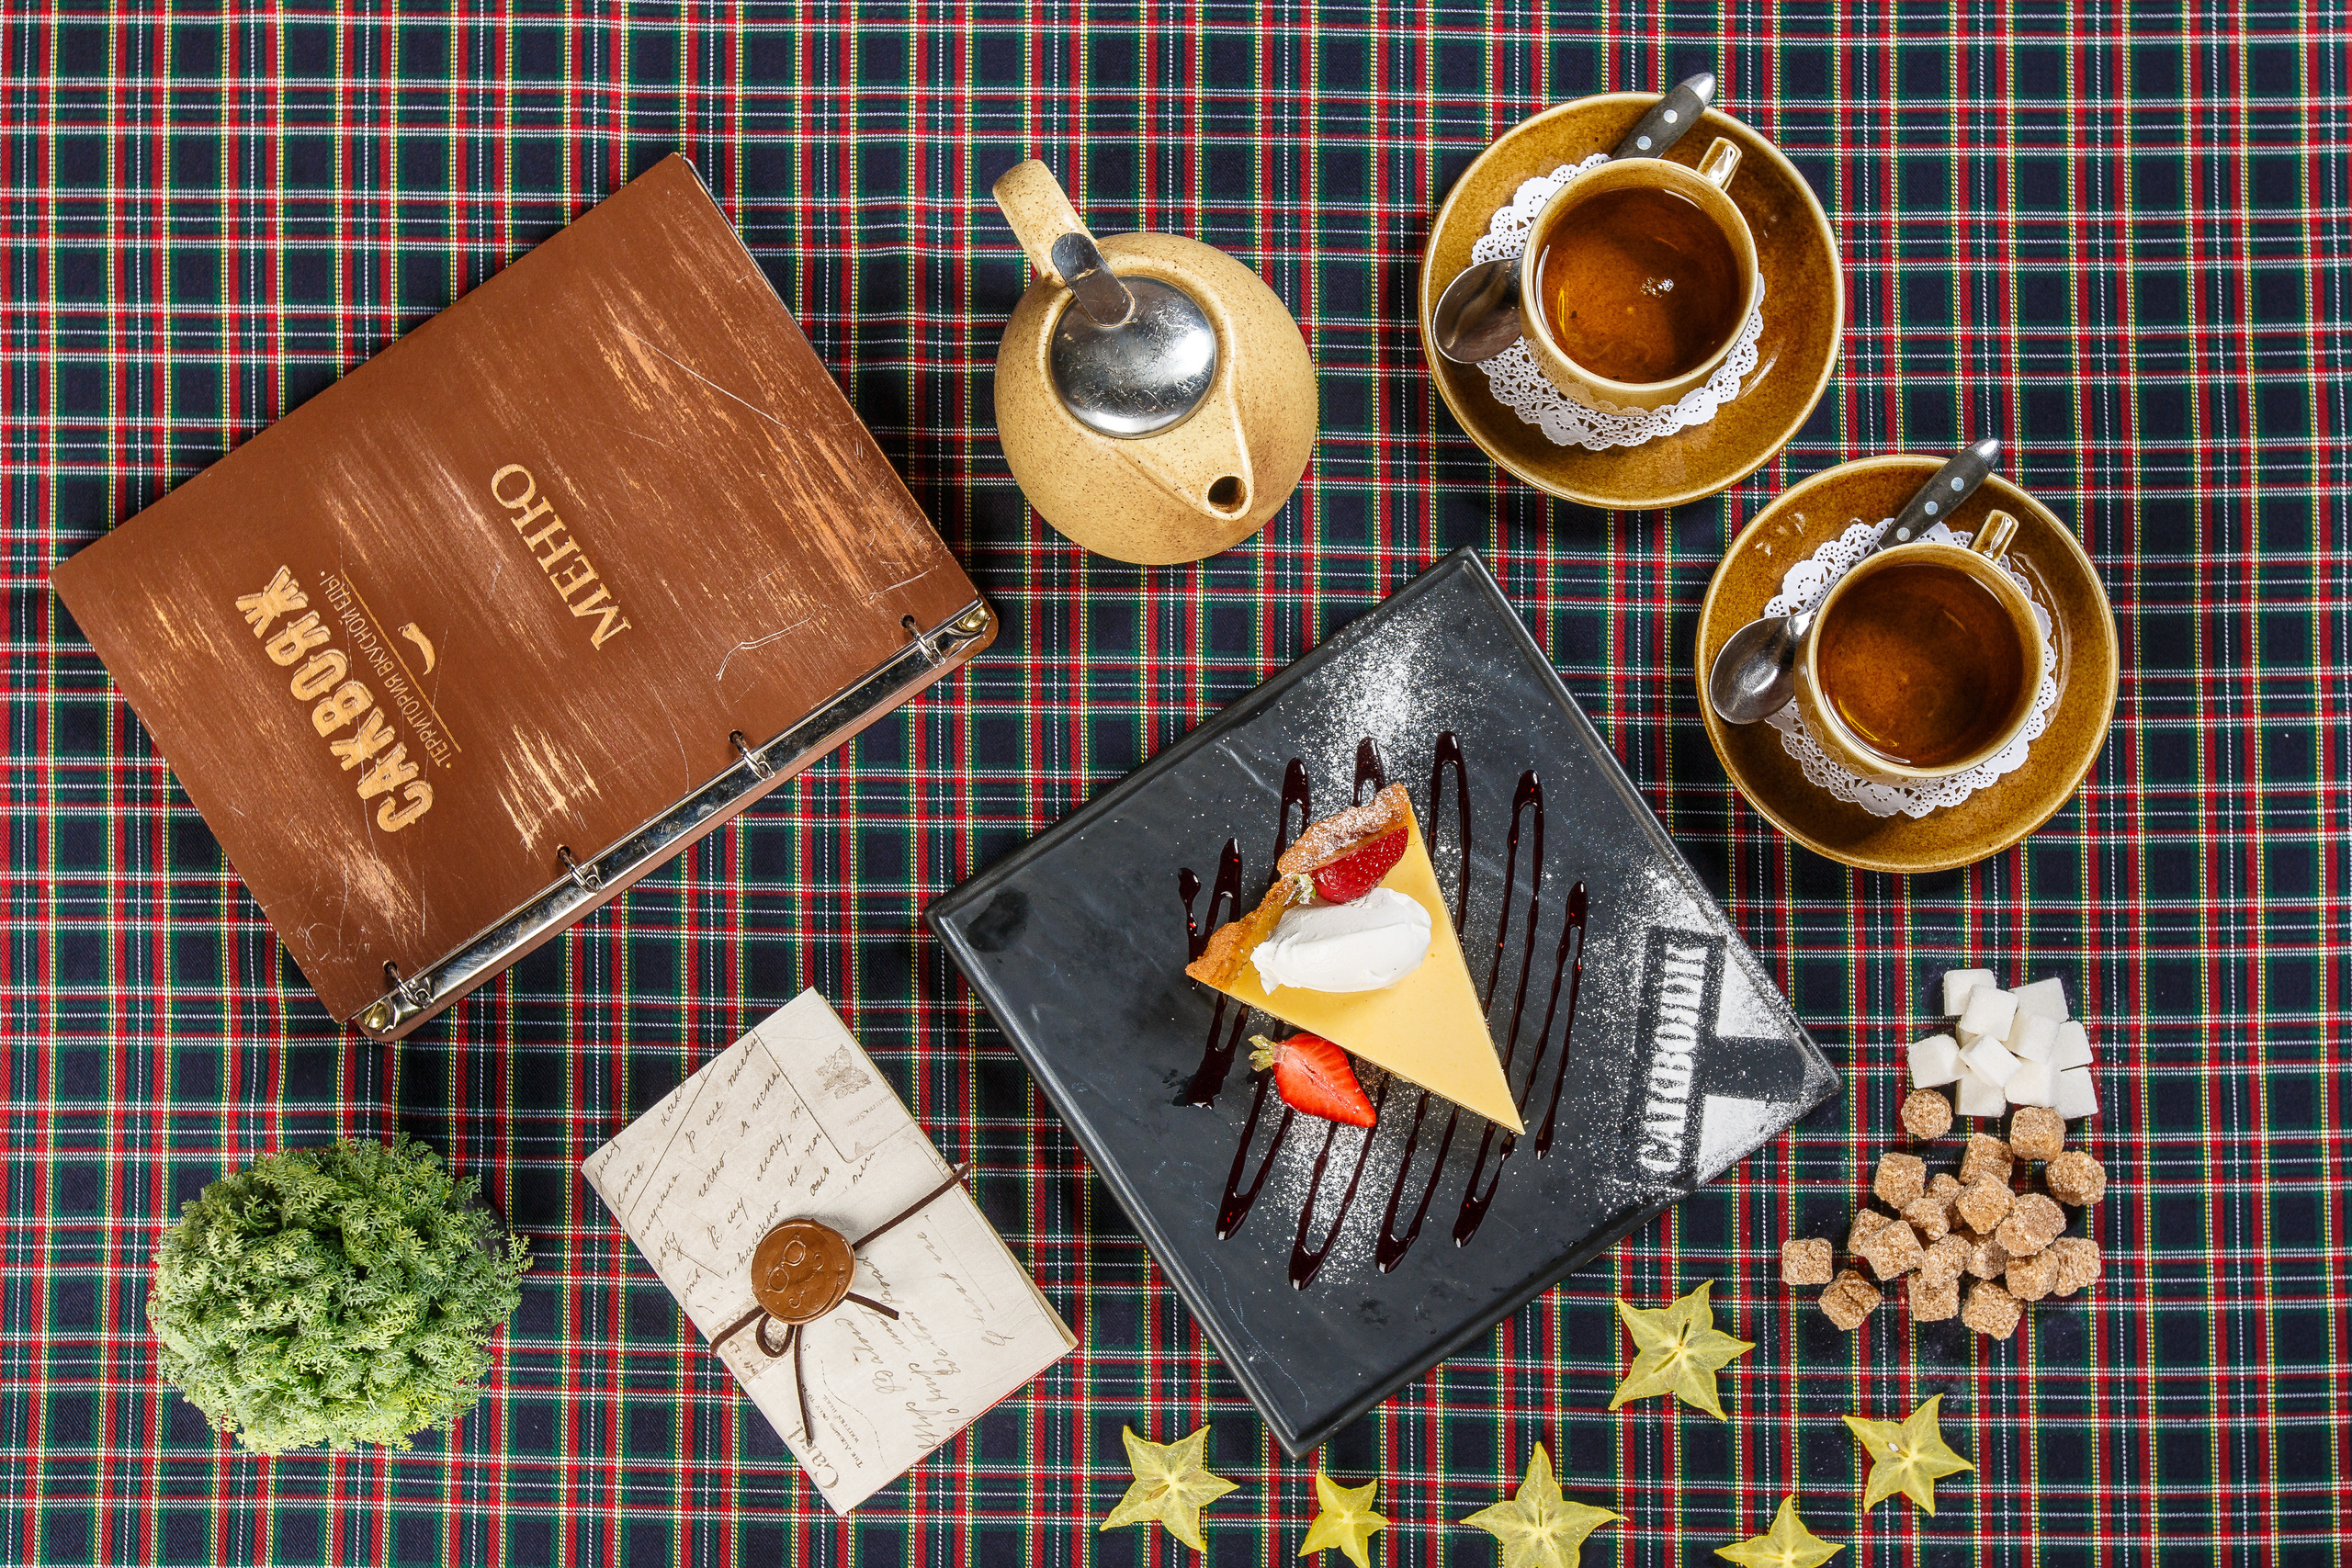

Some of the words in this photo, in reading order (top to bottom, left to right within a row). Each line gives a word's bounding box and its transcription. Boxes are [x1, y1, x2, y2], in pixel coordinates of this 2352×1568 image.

[490, 463, 632, 651] МЕНЮ
[235, 564, 434, 833] САКВОЯЖ
[338, 607, 395, 677] ВКУСНОЙ
[787, 1420, 840, 1490] Card.
